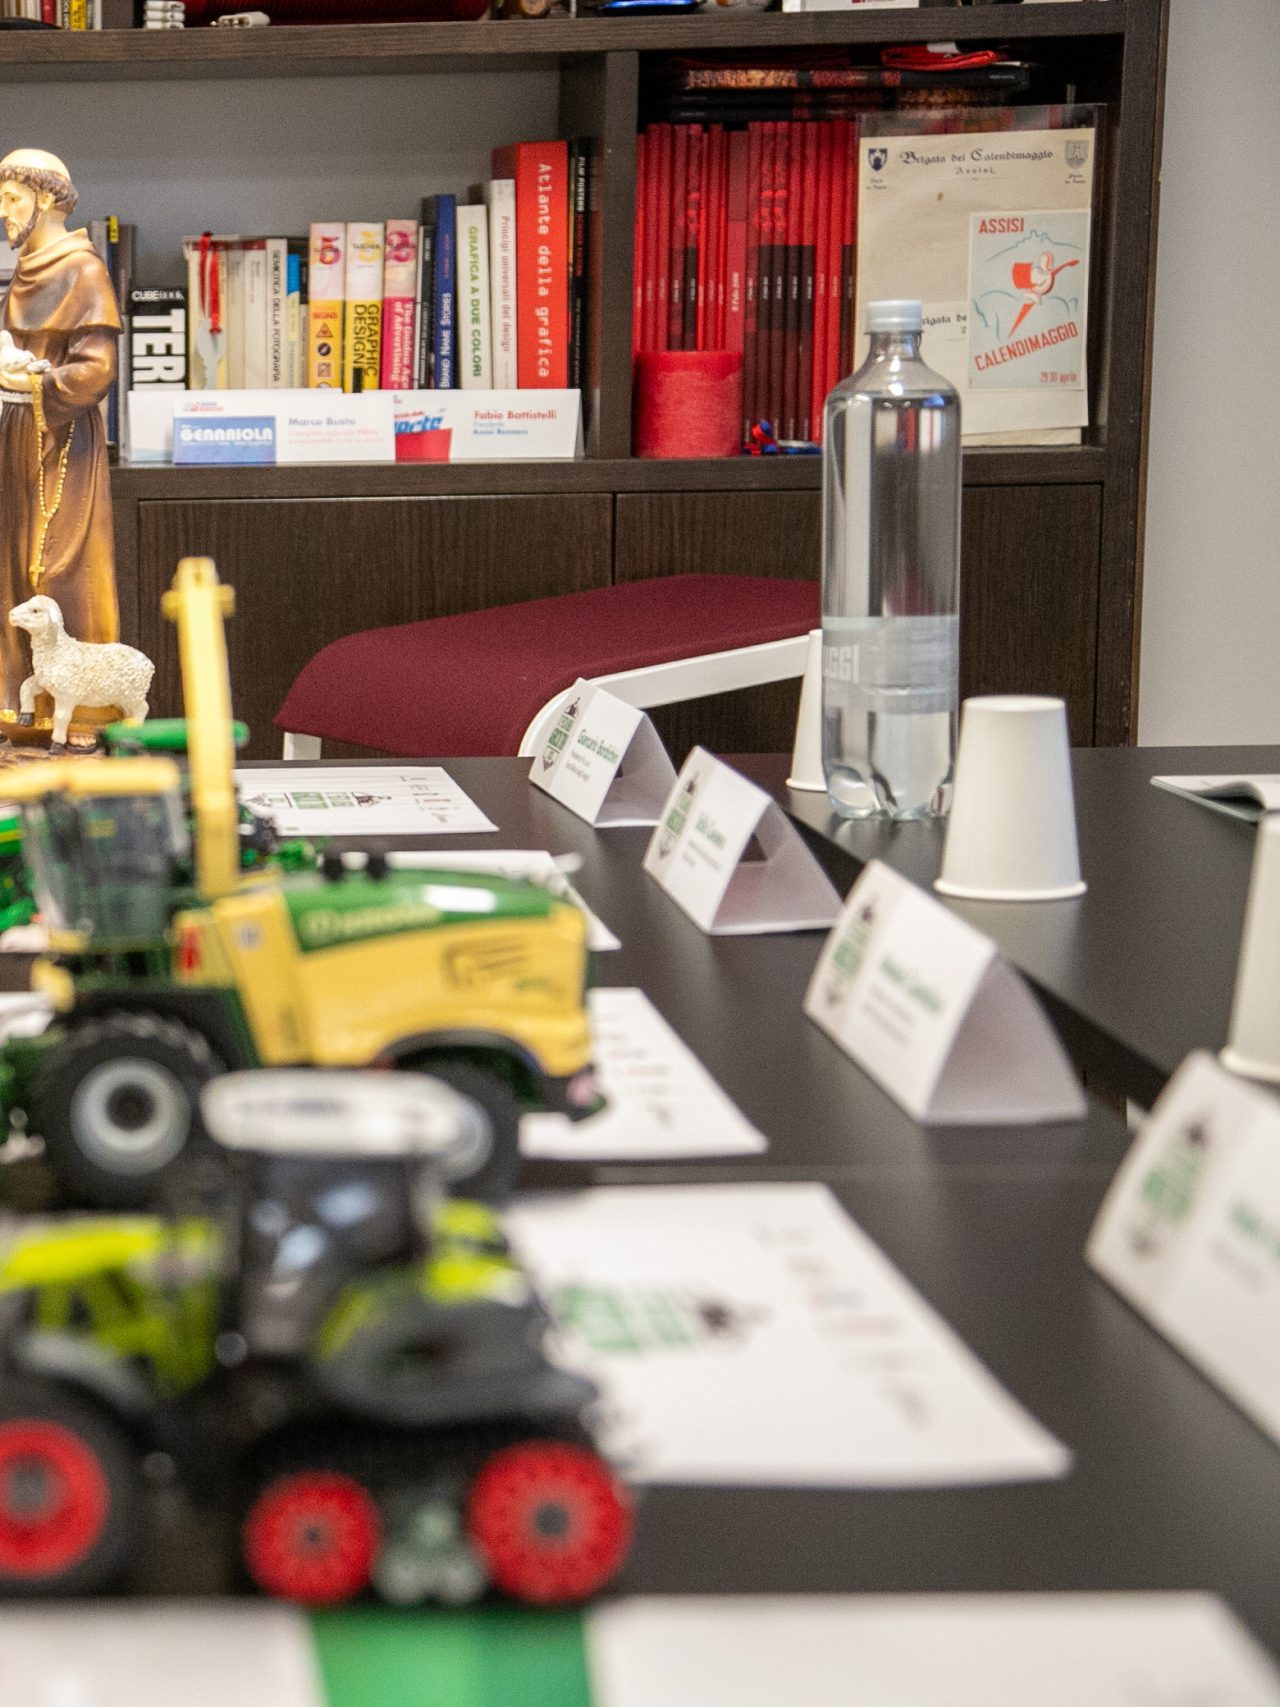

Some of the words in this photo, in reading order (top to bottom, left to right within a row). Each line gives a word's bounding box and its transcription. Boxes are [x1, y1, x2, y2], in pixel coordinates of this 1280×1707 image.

[900, 150, 946, 165] Brigata
[971, 148, 1054, 163] Calendimaggio
[537, 163, 552, 235] Atlante
[576, 177, 585, 212] POSTERS
[500, 216, 511, 252] Principi
[978, 217, 1024, 235] ASSISI
[468, 226, 479, 282] GRAFICA
[538, 245, 552, 296] della
[272, 249, 281, 294] SEMIOTICA
[501, 255, 511, 300] universali
[470, 286, 479, 294] A
[272, 298, 281, 325] DELLA
[313, 311, 339, 320] SIGNS
[441, 293, 452, 326] STORIES
[471, 299, 481, 324] DUE
[502, 304, 511, 318] del
[922, 314, 951, 325] rigata
[956, 313, 967, 322] de
[353, 304, 367, 365] DESIGN
[366, 304, 380, 377] GRAPHIC
[403, 325, 412, 365] Golden
[440, 330, 451, 355] NAME
[501, 322, 512, 352] design
[535, 306, 552, 378] grafica
[974, 321, 1079, 371] CALENDIMAGGIO
[272, 328, 281, 382] FOTOGRAFIA
[472, 329, 482, 377] COLORI
[401, 367, 411, 389] Age
[440, 359, 451, 388] BRAND
[288, 418, 322, 426] Marco
[474, 409, 504, 420] Fabio
[507, 409, 557, 420] Battistelli
